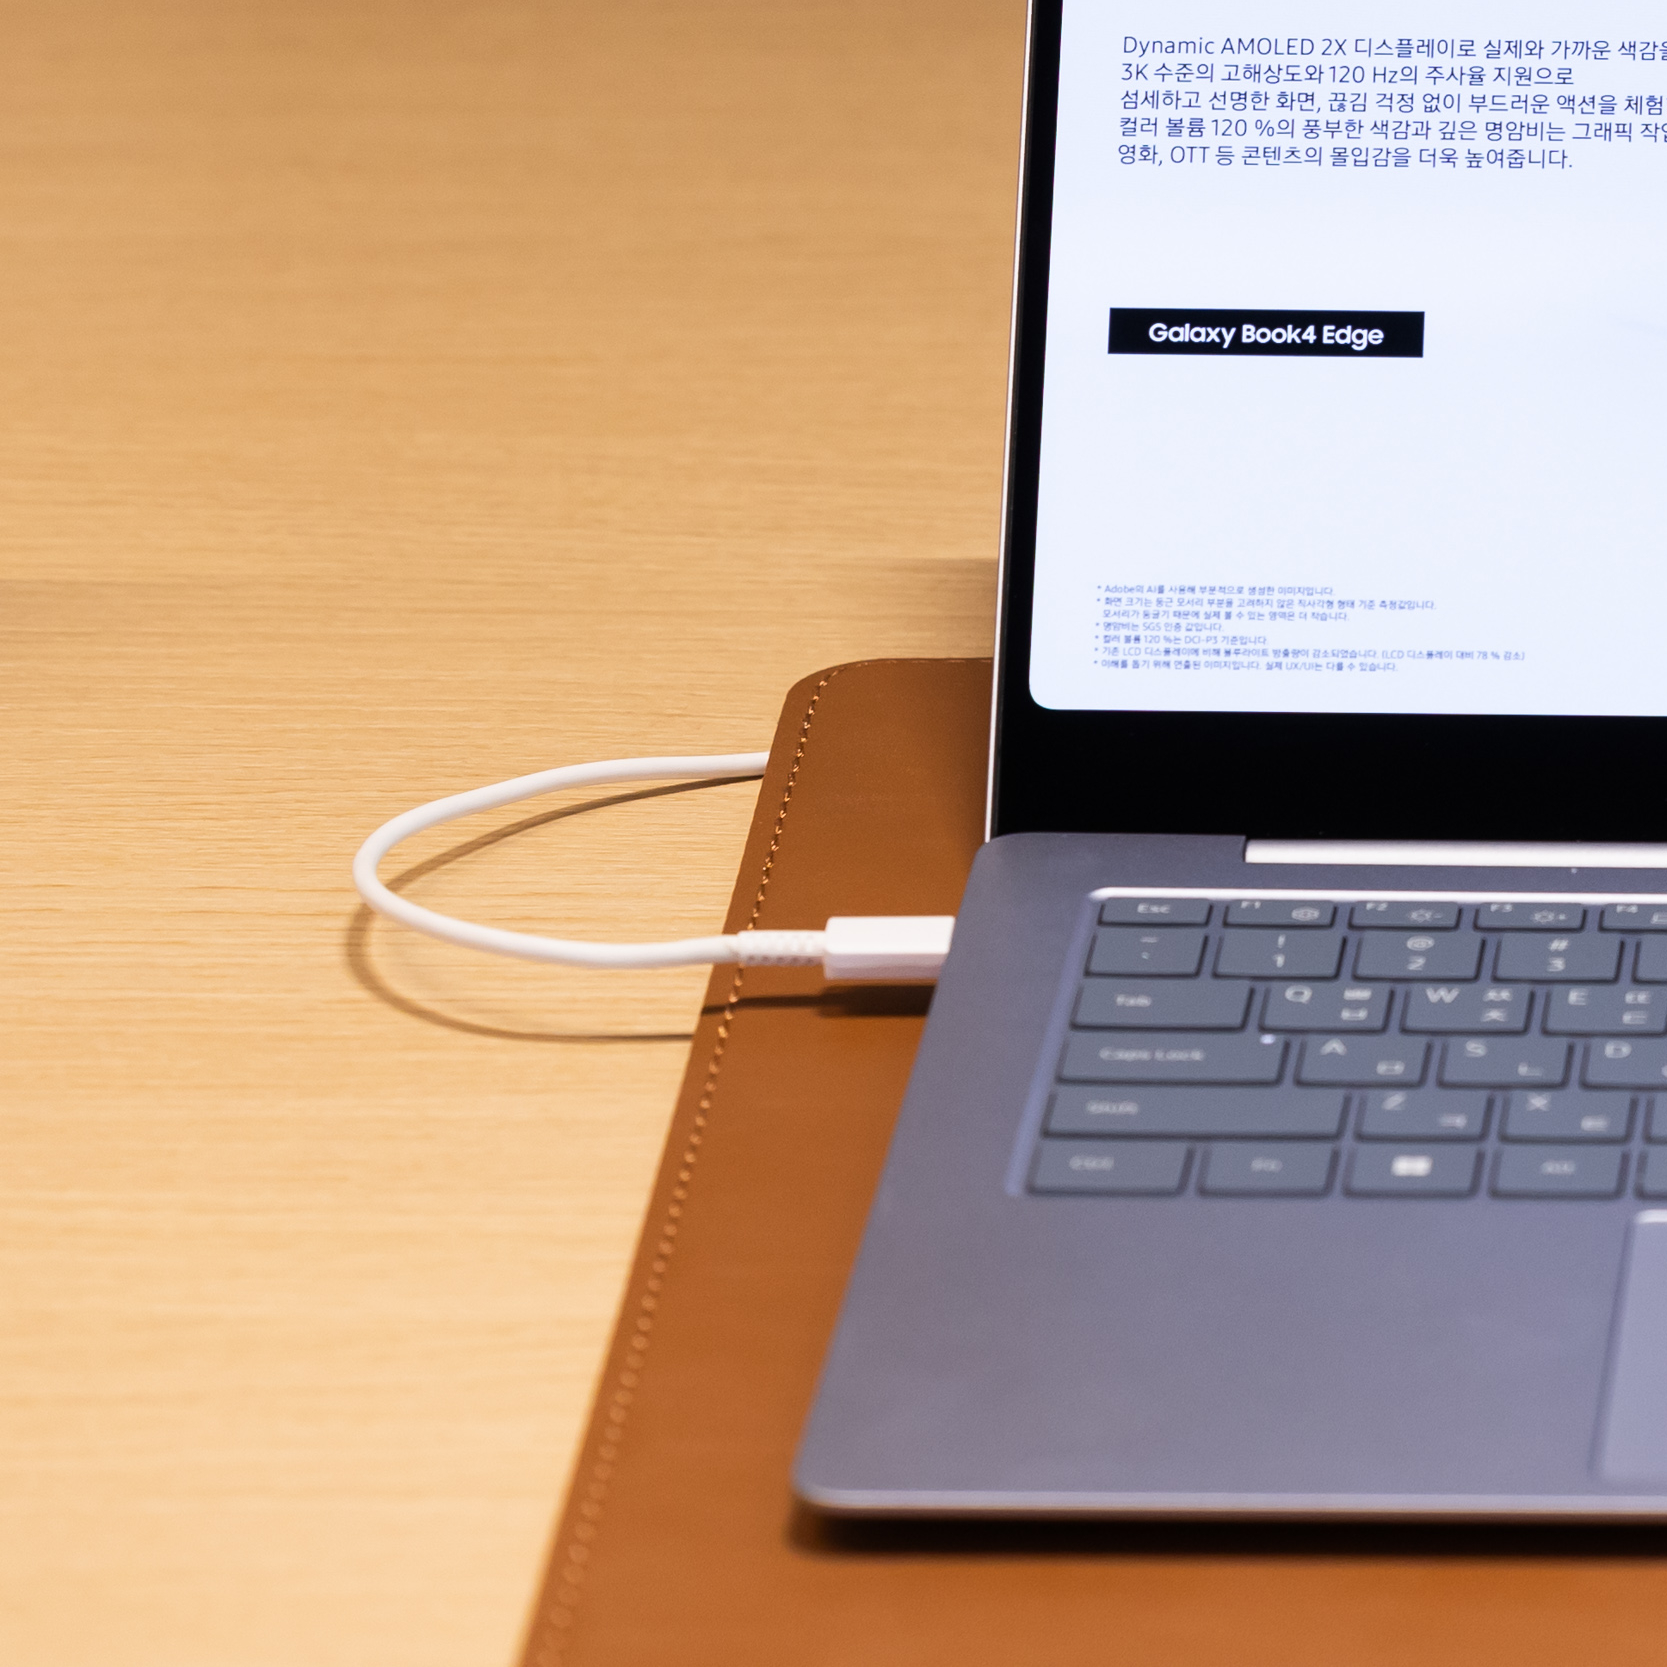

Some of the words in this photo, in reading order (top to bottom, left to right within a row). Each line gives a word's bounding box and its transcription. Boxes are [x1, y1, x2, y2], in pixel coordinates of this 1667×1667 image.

[1124, 36, 1214, 58] Dynamic
[1221, 37, 1314, 56] AMOLED
[1322, 38, 1346, 56] 2X
[1355, 37, 1476, 59] 디스플레이로
[1484, 39, 1544, 60] 실제와
[1552, 40, 1611, 60] 가까운
[1122, 62, 1148, 81] 3K
[1154, 63, 1213, 83] 수준의
[1221, 64, 1324, 85] 고해상도와
[1329, 65, 1364, 84] 120
[1373, 65, 1417, 85] Hz의
[1426, 65, 1486, 87] 주사율
[1493, 66, 1574, 87] 지원으로
[1121, 89, 1201, 110] 섬세하고
[1209, 90, 1270, 112] 선명한
[1276, 91, 1320, 114] 화면,
[1329, 92, 1366, 112] 끊김
[1376, 93, 1413, 114] 걱정
[1423, 93, 1460, 113] 없이
[1469, 93, 1549, 114] 부드러운
[1557, 94, 1617, 116] 액션을
[1120, 117, 1157, 137] 컬러
[1166, 117, 1205, 138] 볼륨
[1212, 119, 1247, 137] 120
[1255, 118, 1294, 139] %의
[1303, 119, 1364, 140] 풍부한
[1370, 119, 1431, 141] 색감과
[1439, 120, 1477, 141] 깊은
[1486, 120, 1565, 142] 명암비는
[1573, 122, 1632, 143] 그래픽
[1118, 144, 1162, 167] 영화,
[1171, 146, 1211, 166] OTT
[1216, 146, 1235, 167] 등
[1242, 146, 1322, 167] 콘텐츠의
[1330, 147, 1412, 169] 몰입감을
[1420, 147, 1458, 168] 더욱
[1465, 148, 1572, 170] 높여줍니다.
[1149, 323, 1236, 349] Galaxy
[1242, 324, 1317, 344] Book4
[1323, 325, 1384, 351] Edge
[1137, 903, 1171, 914] Esc
